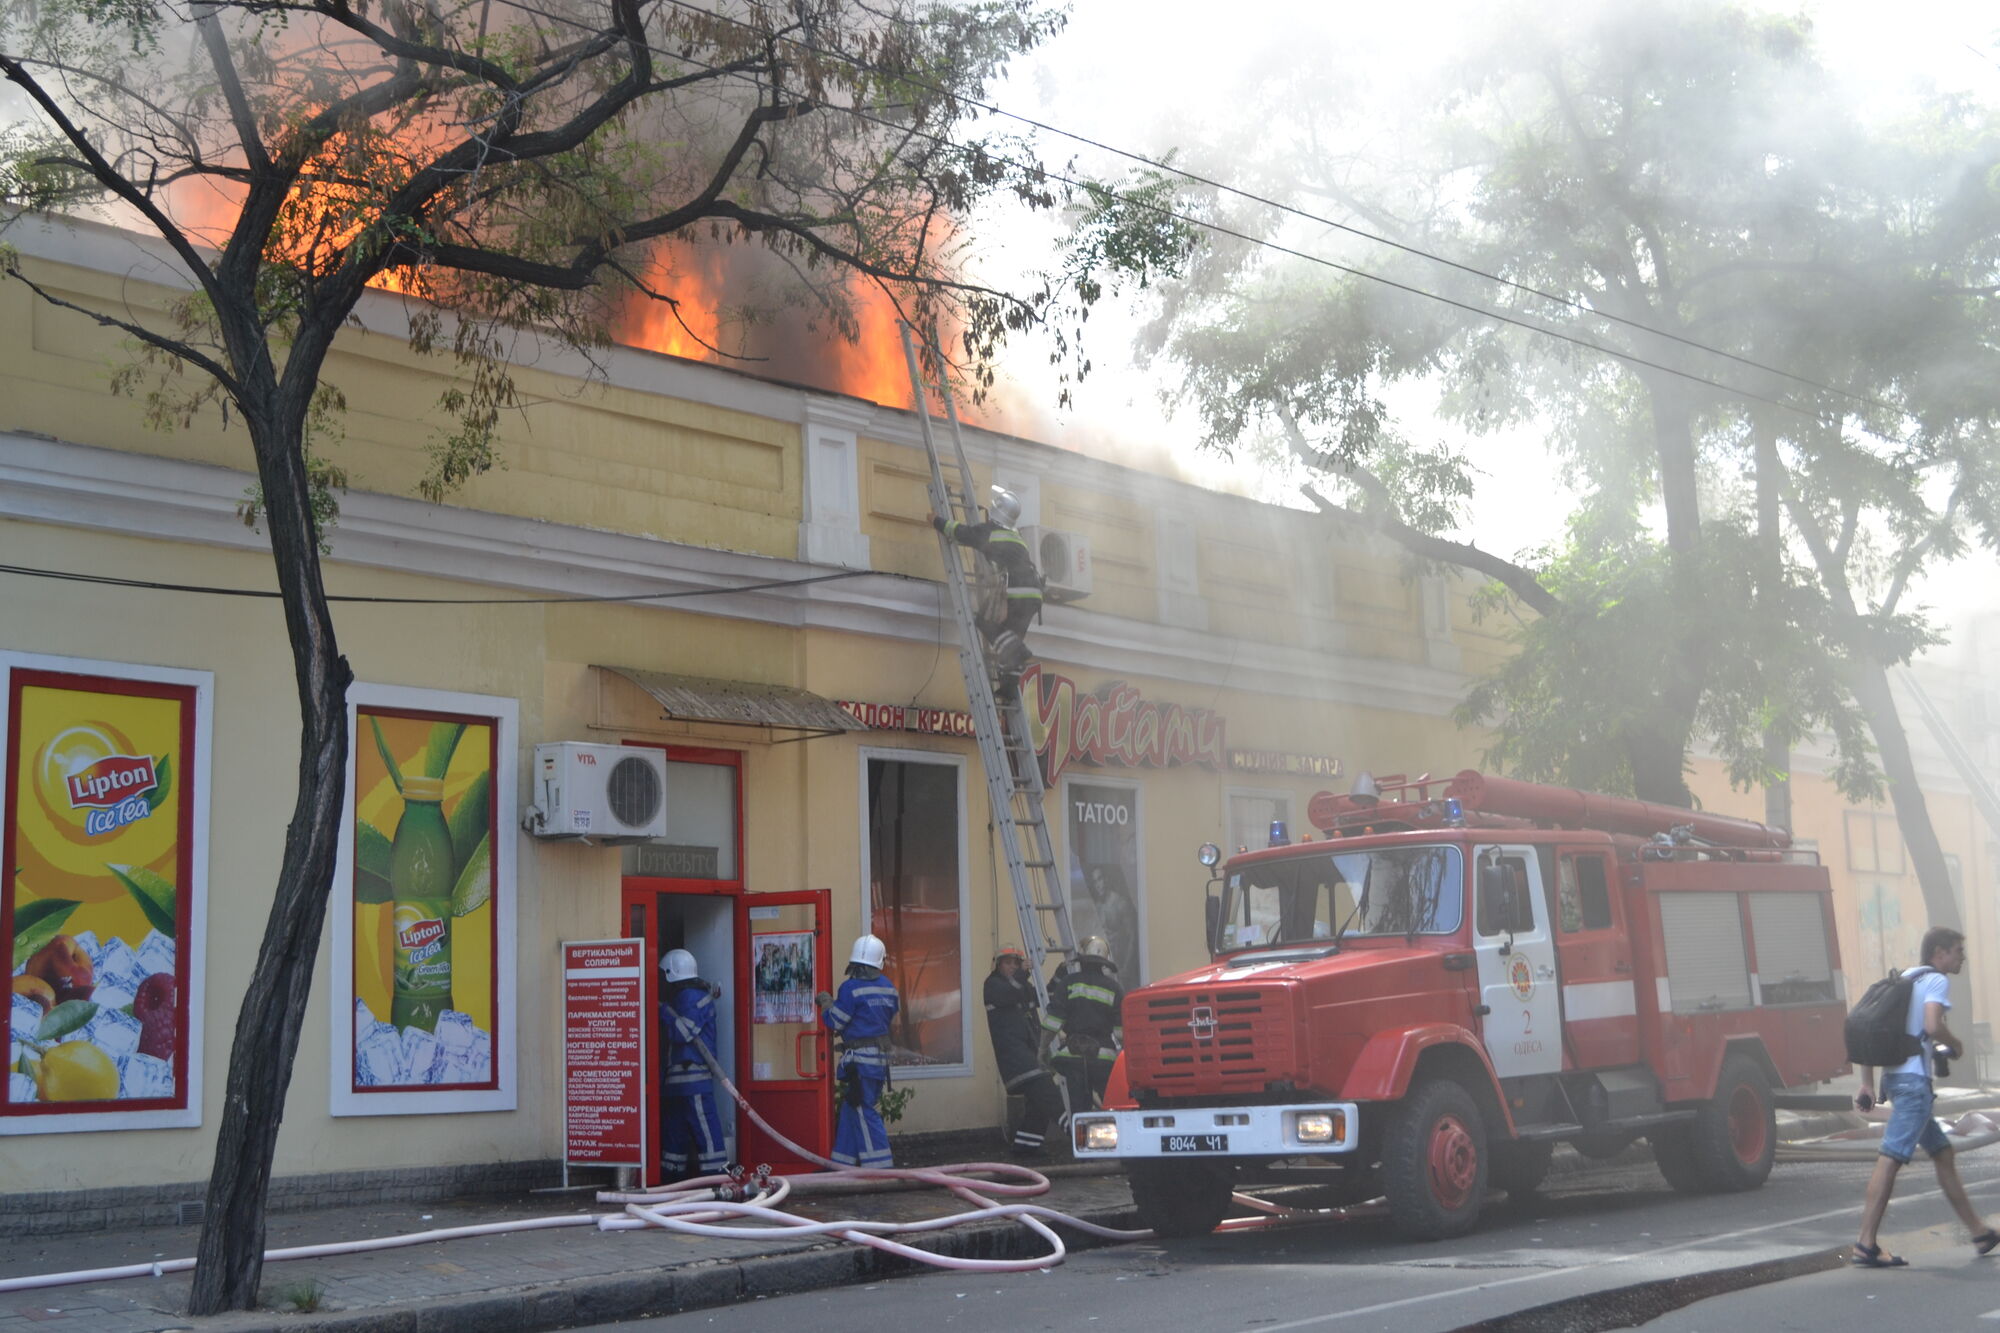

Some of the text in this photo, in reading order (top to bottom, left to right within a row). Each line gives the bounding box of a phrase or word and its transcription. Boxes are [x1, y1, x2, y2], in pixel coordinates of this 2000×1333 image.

[576, 752, 597, 767] VITA
[74, 766, 149, 799] Lipton
[87, 797, 150, 835] Ice Tea
[1075, 801, 1129, 825] TATOO
[642, 852, 717, 874] ОТКРЫТО
[403, 925, 441, 945] Lipton
[410, 942, 442, 963] Ice Tea
[572, 947, 633, 958] ВЕРТИКАЛЬНЫЙ
[584, 957, 620, 967] СОЛЯРИЙ
[567, 1011, 637, 1019] ПАРИКМАХЕРСКИЕ
[1522, 1009, 1533, 1035] 2
[567, 1040, 638, 1049] НОГТЕВОЙ СЕРВИС
[1514, 1039, 1544, 1057] ОДЕСА
[568, 1105, 638, 1113] КОРРЕКЦИЯ ФИГУРЫ
[568, 1139, 597, 1147] ТАТУАЖ
[1169, 1136, 1197, 1151] 8044
[568, 1149, 603, 1157] ПИРСИНГ
